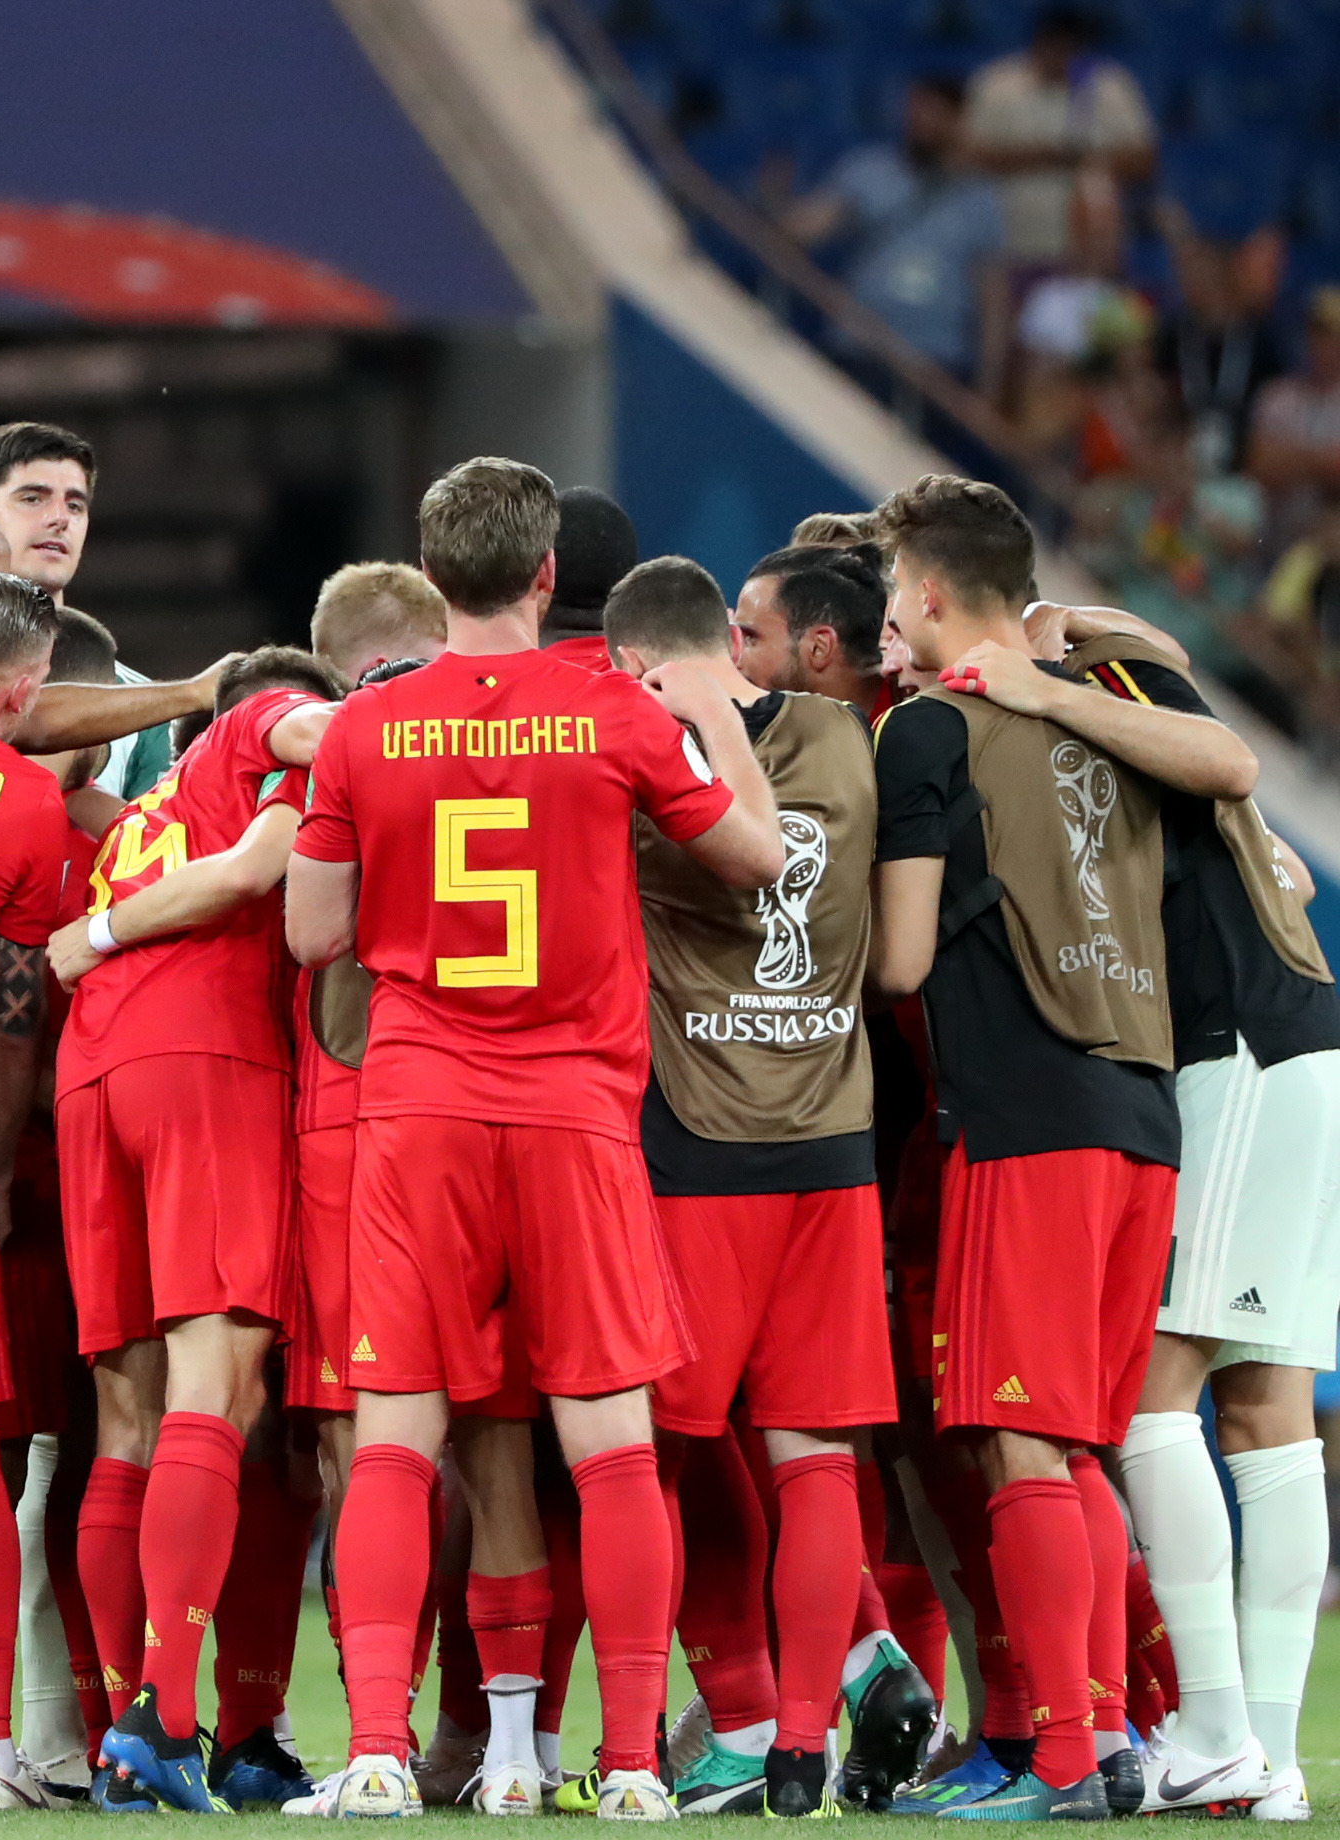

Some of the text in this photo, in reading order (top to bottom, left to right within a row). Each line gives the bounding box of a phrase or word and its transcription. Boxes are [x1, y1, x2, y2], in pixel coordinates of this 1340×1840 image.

[382, 715, 596, 759] VERTONGHEN
[434, 797, 538, 988] 5
[729, 994, 832, 1010] FIFA WORLD CUP
[685, 1011, 805, 1043] RUSSIA
[1229, 1302, 1267, 1314] adidas
[992, 1392, 1030, 1403] adidas
